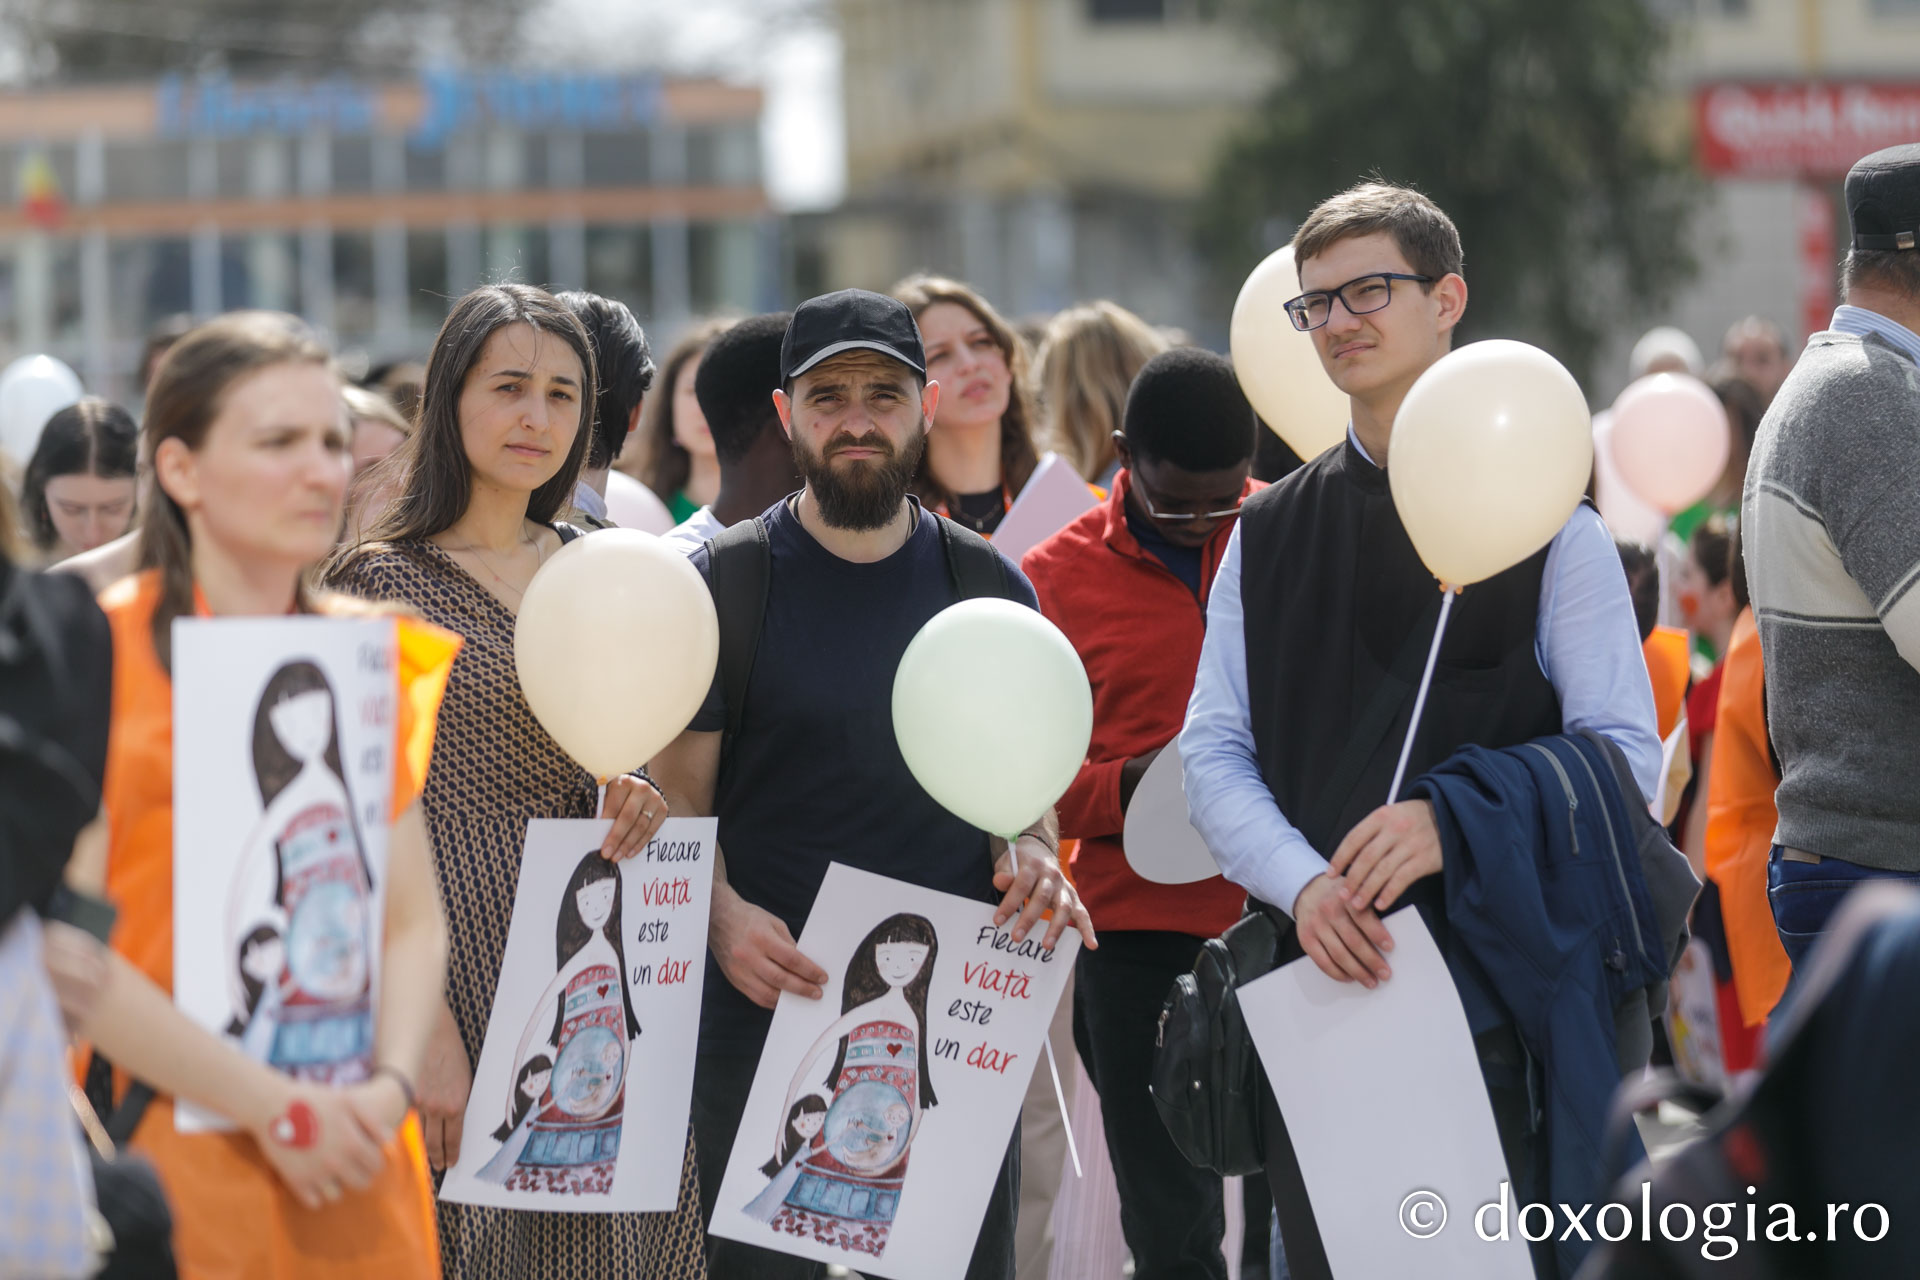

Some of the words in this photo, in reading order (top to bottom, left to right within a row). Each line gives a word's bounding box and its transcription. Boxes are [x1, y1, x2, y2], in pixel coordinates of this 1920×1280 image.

[646, 838, 701, 863] Fiecare
[643, 876, 692, 911] viață
[638, 917, 669, 943] este
[633, 964, 651, 985] un
[657, 956, 692, 985] dar
[964, 961, 1034, 999] viață
[948, 998, 993, 1025] este
[934, 1037, 960, 1061] un
[966, 1041, 1018, 1074] dar
